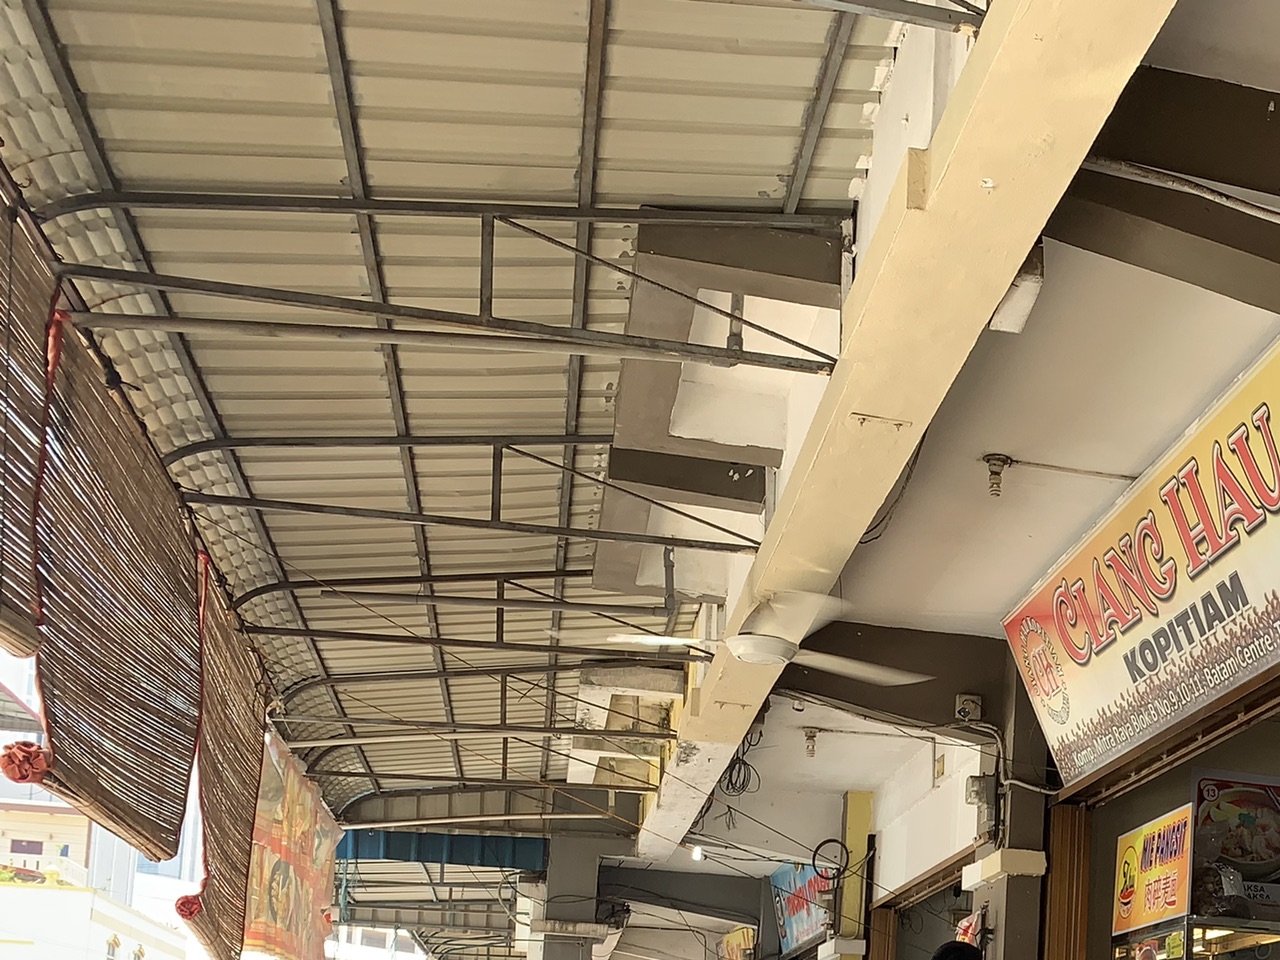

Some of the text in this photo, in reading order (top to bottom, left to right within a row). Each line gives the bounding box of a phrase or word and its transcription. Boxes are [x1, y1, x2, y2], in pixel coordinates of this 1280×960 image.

[1051, 509, 1177, 665] CIANG
[1121, 570, 1250, 685] KOPITIAM
[1093, 735, 1116, 757] Mitra
[1112, 724, 1134, 746] Raya
[1130, 710, 1151, 735] Blok
[1149, 704, 1158, 725] B
[1203, 656, 1238, 689] Batam
[1205, 788, 1217, 798] 13
